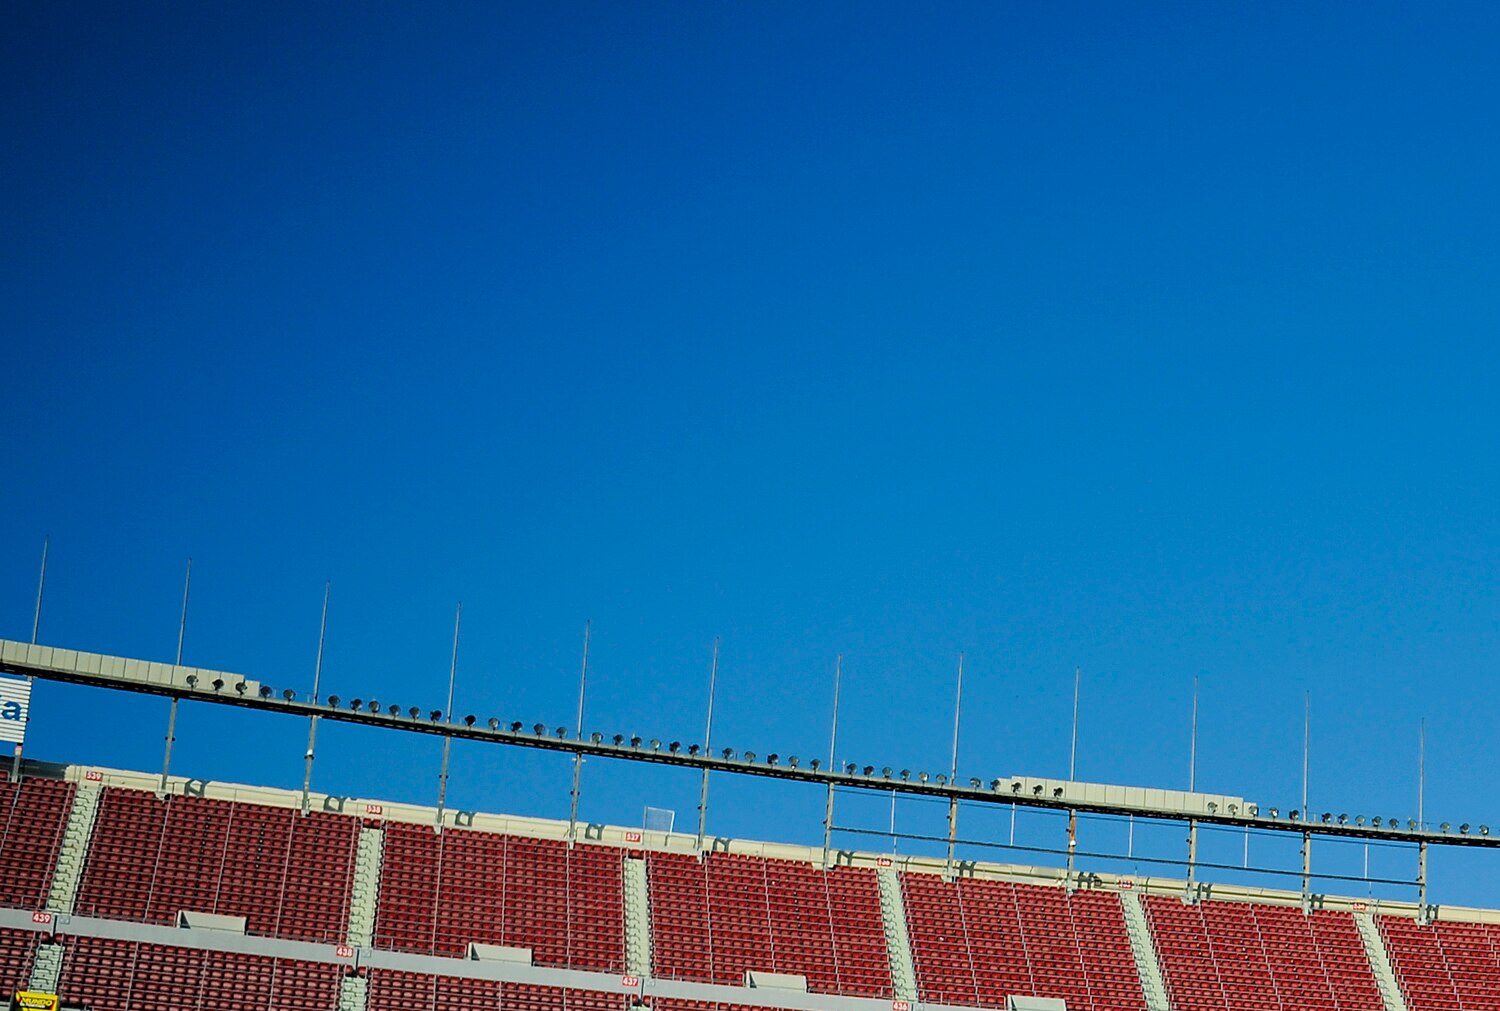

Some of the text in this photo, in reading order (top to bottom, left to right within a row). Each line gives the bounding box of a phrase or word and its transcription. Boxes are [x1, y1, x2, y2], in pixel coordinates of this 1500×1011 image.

[627, 831, 640, 842] 537
[33, 912, 51, 923] 439
[337, 946, 352, 957] 438
[622, 976, 638, 986] 437
[893, 1001, 909, 1011] 436
